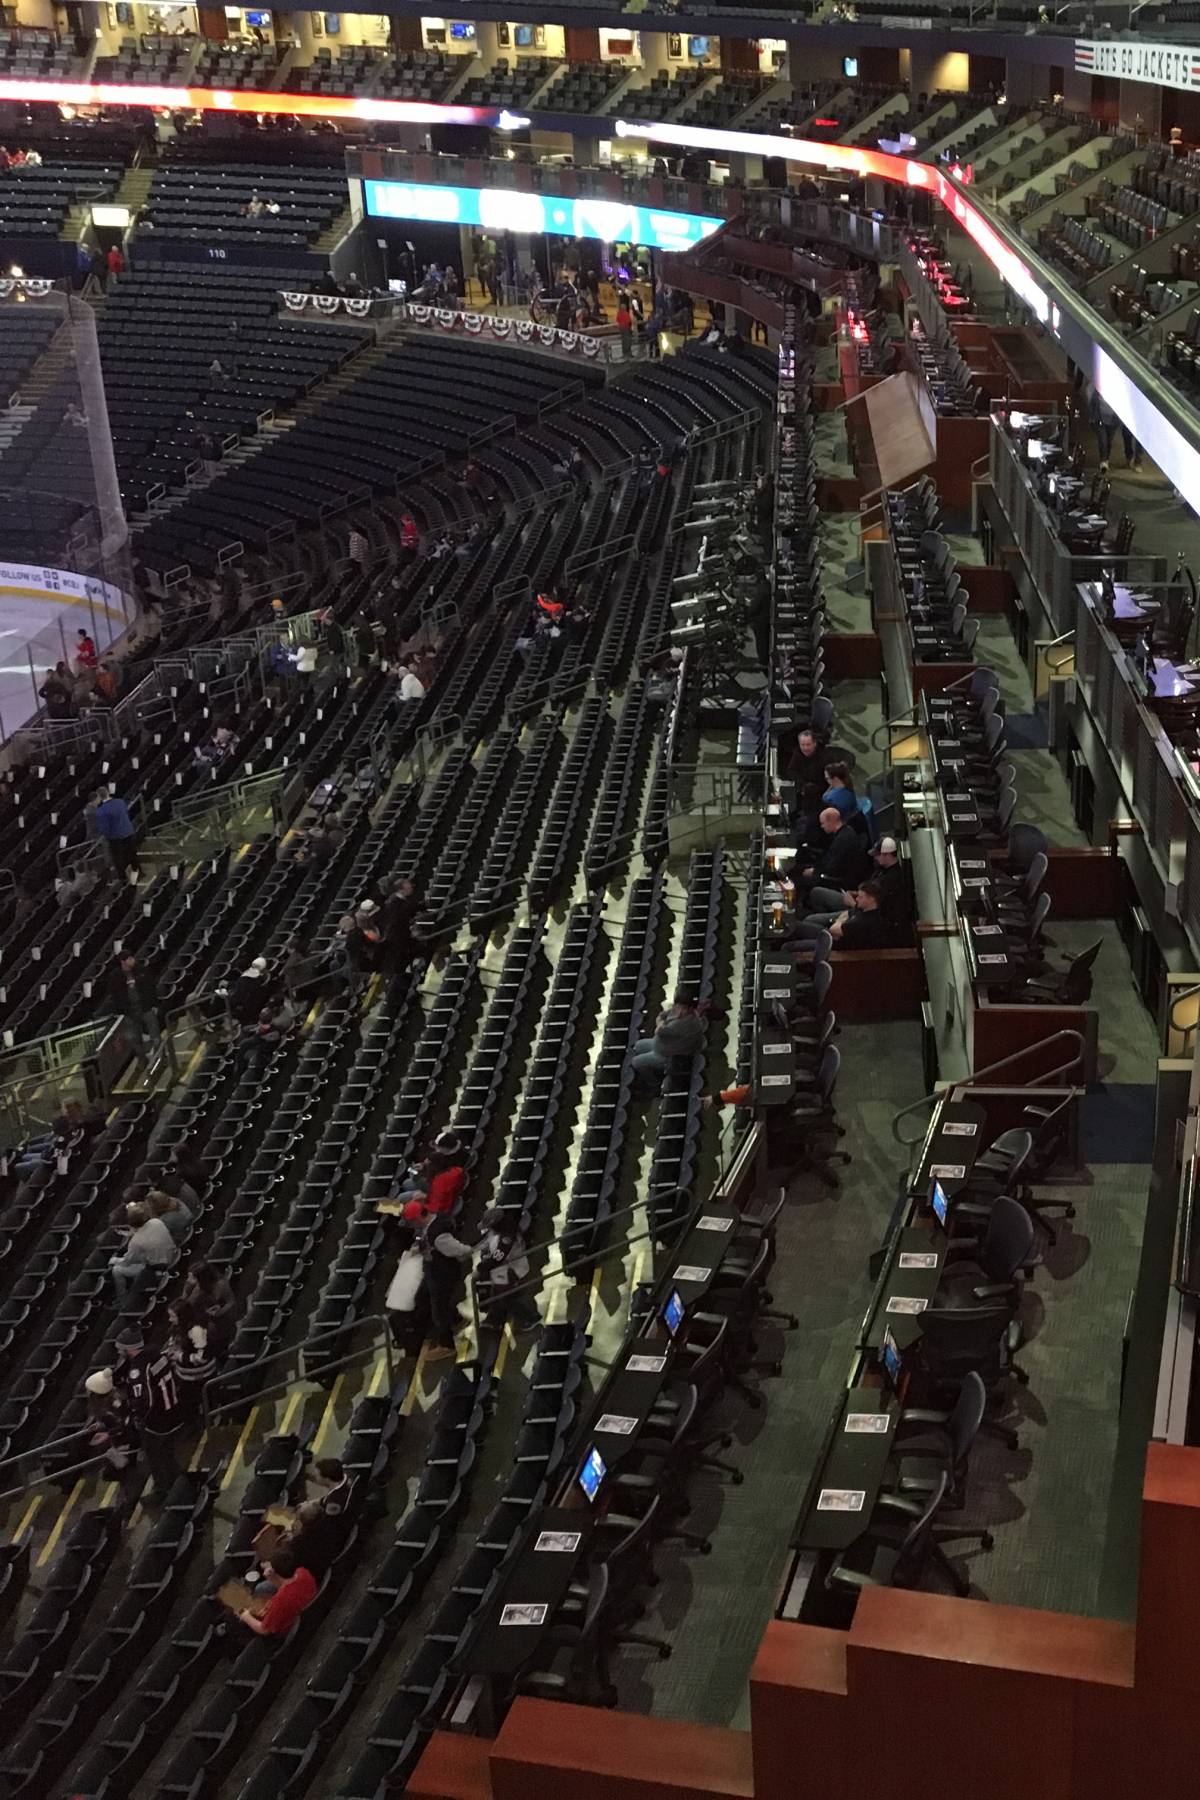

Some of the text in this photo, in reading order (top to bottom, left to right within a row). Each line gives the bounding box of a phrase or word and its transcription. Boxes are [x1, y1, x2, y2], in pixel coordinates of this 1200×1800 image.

[1121, 48, 1133, 74] GO
[1136, 50, 1188, 84] JACKETS
[209, 249, 226, 259] 110
[0, 570, 30, 580] OLLOW
[158, 1371, 178, 1410] 17
